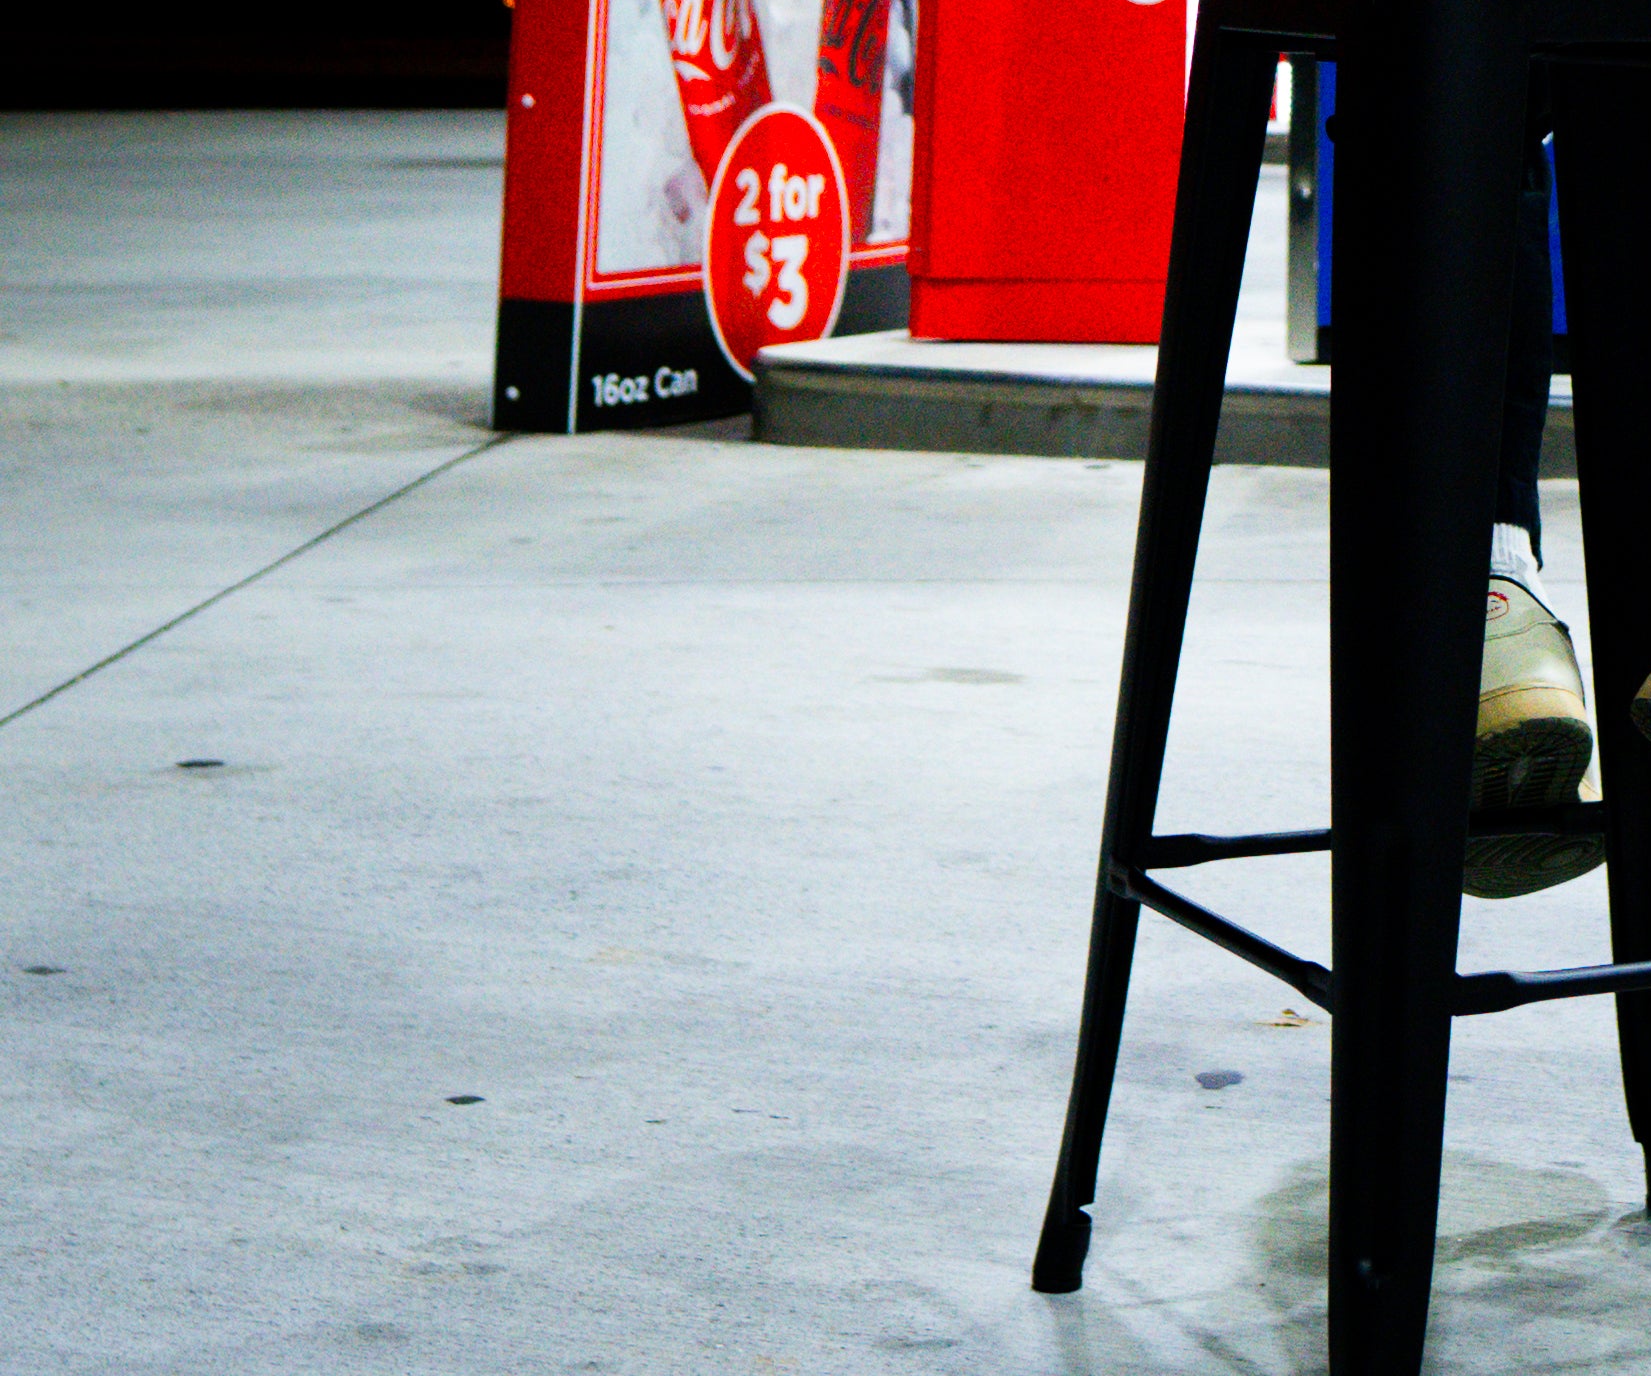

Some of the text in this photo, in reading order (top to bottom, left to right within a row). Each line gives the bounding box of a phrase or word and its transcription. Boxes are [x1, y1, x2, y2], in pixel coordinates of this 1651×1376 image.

[734, 163, 824, 226] 2 for
[742, 229, 809, 331] $3
[592, 366, 699, 408] 16oz Can
